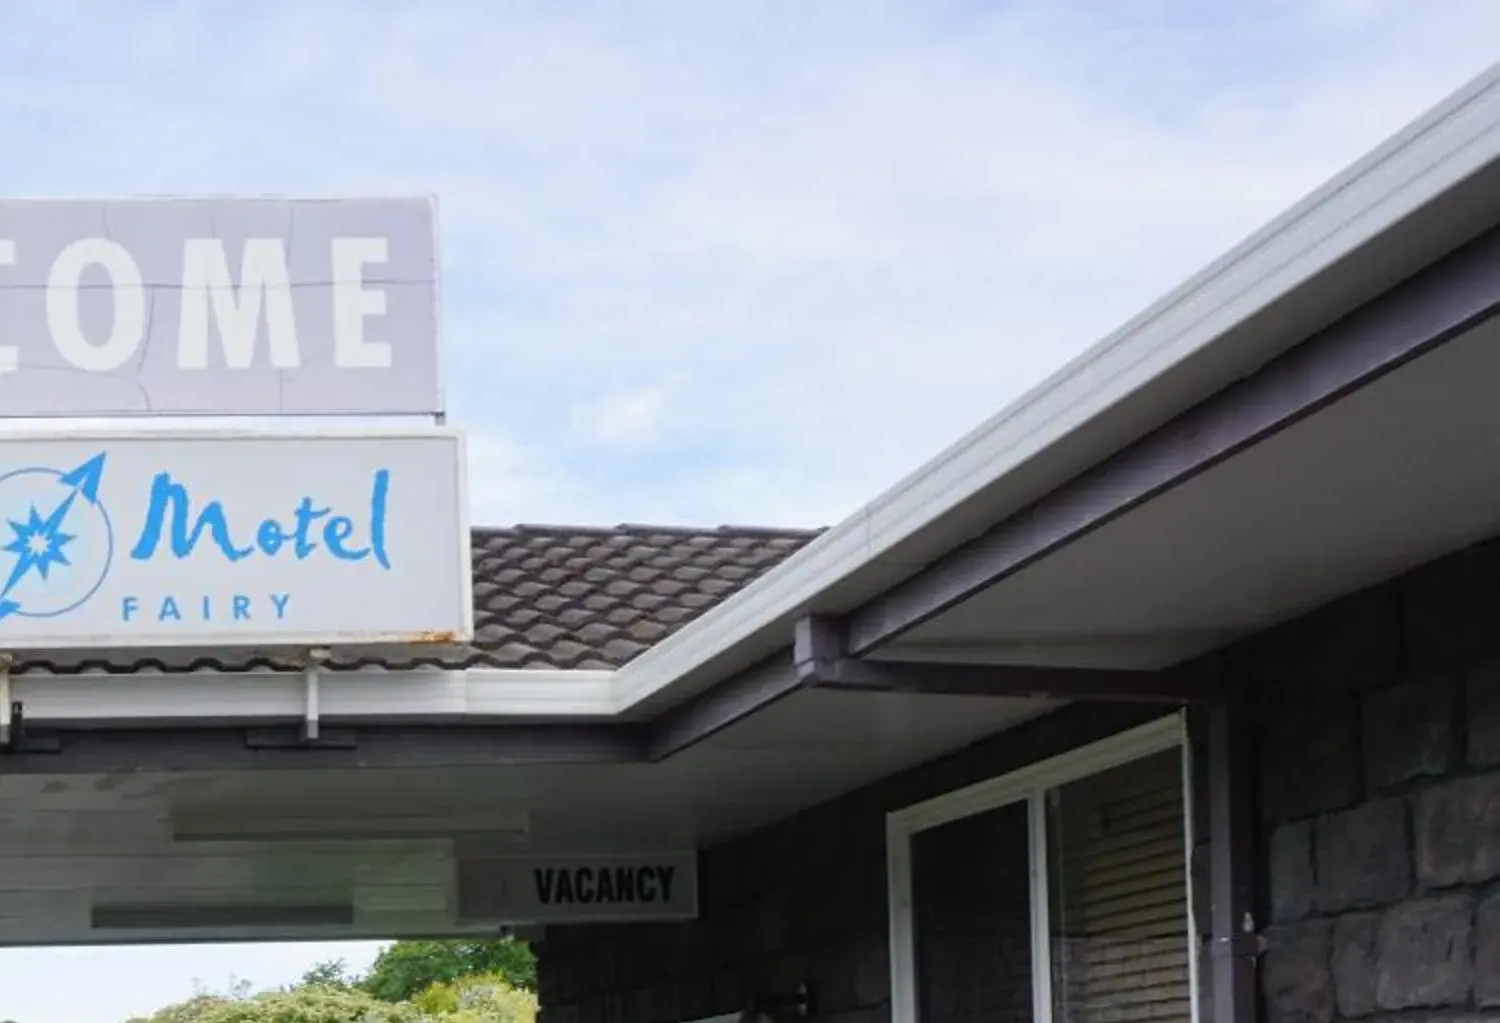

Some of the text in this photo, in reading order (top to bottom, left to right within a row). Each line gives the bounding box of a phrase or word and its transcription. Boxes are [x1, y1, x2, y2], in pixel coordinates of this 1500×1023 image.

[130, 469, 391, 568] Motel
[121, 594, 293, 622] FAIRY
[532, 865, 676, 904] VACANCY
